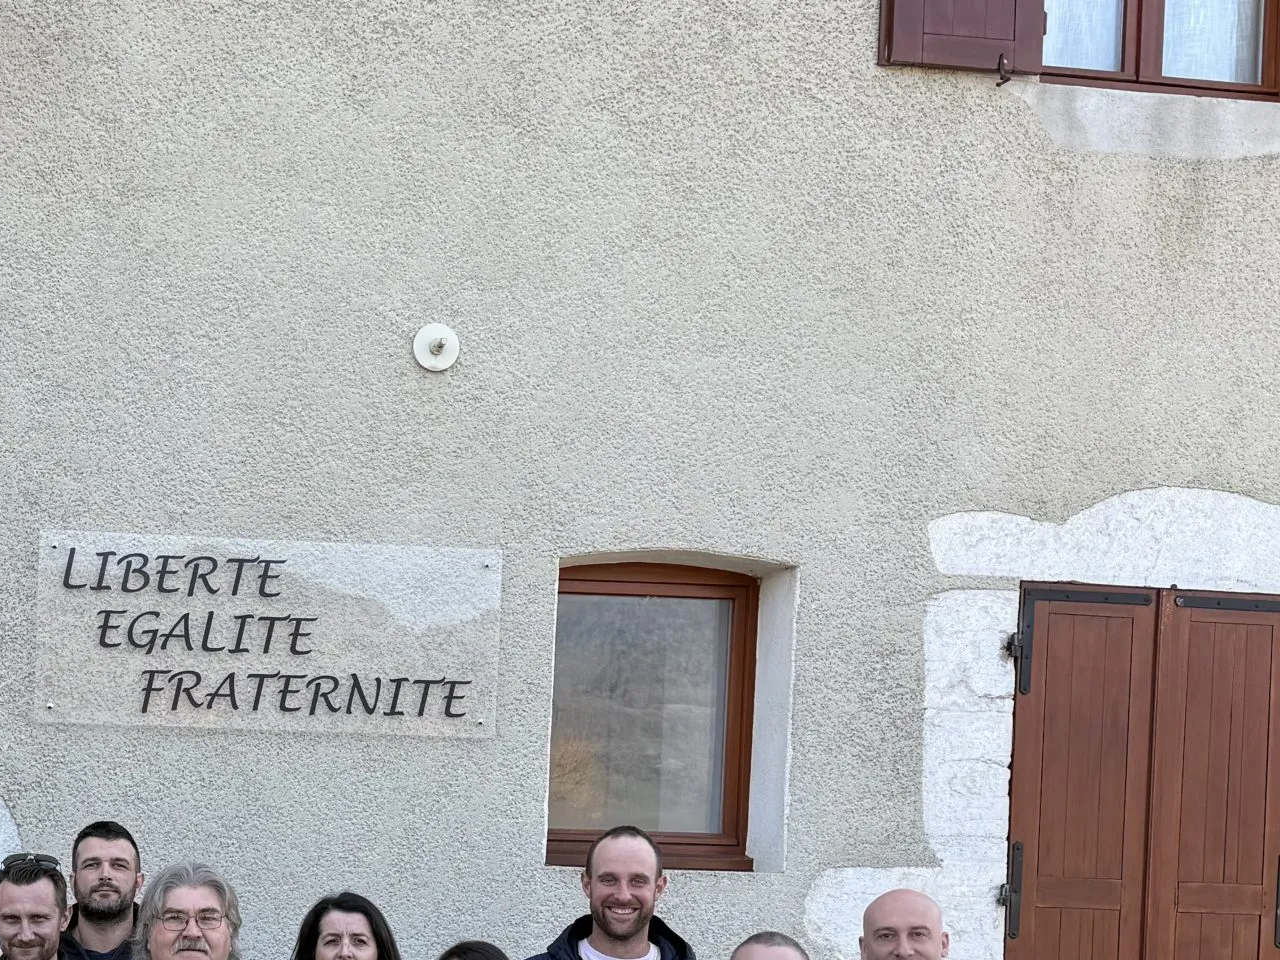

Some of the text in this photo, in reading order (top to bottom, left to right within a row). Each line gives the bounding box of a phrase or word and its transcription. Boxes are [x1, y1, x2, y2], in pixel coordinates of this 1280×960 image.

[62, 547, 287, 598] LIBERTE
[96, 609, 318, 655] EGALITE
[141, 669, 473, 718] FRATERNITE
